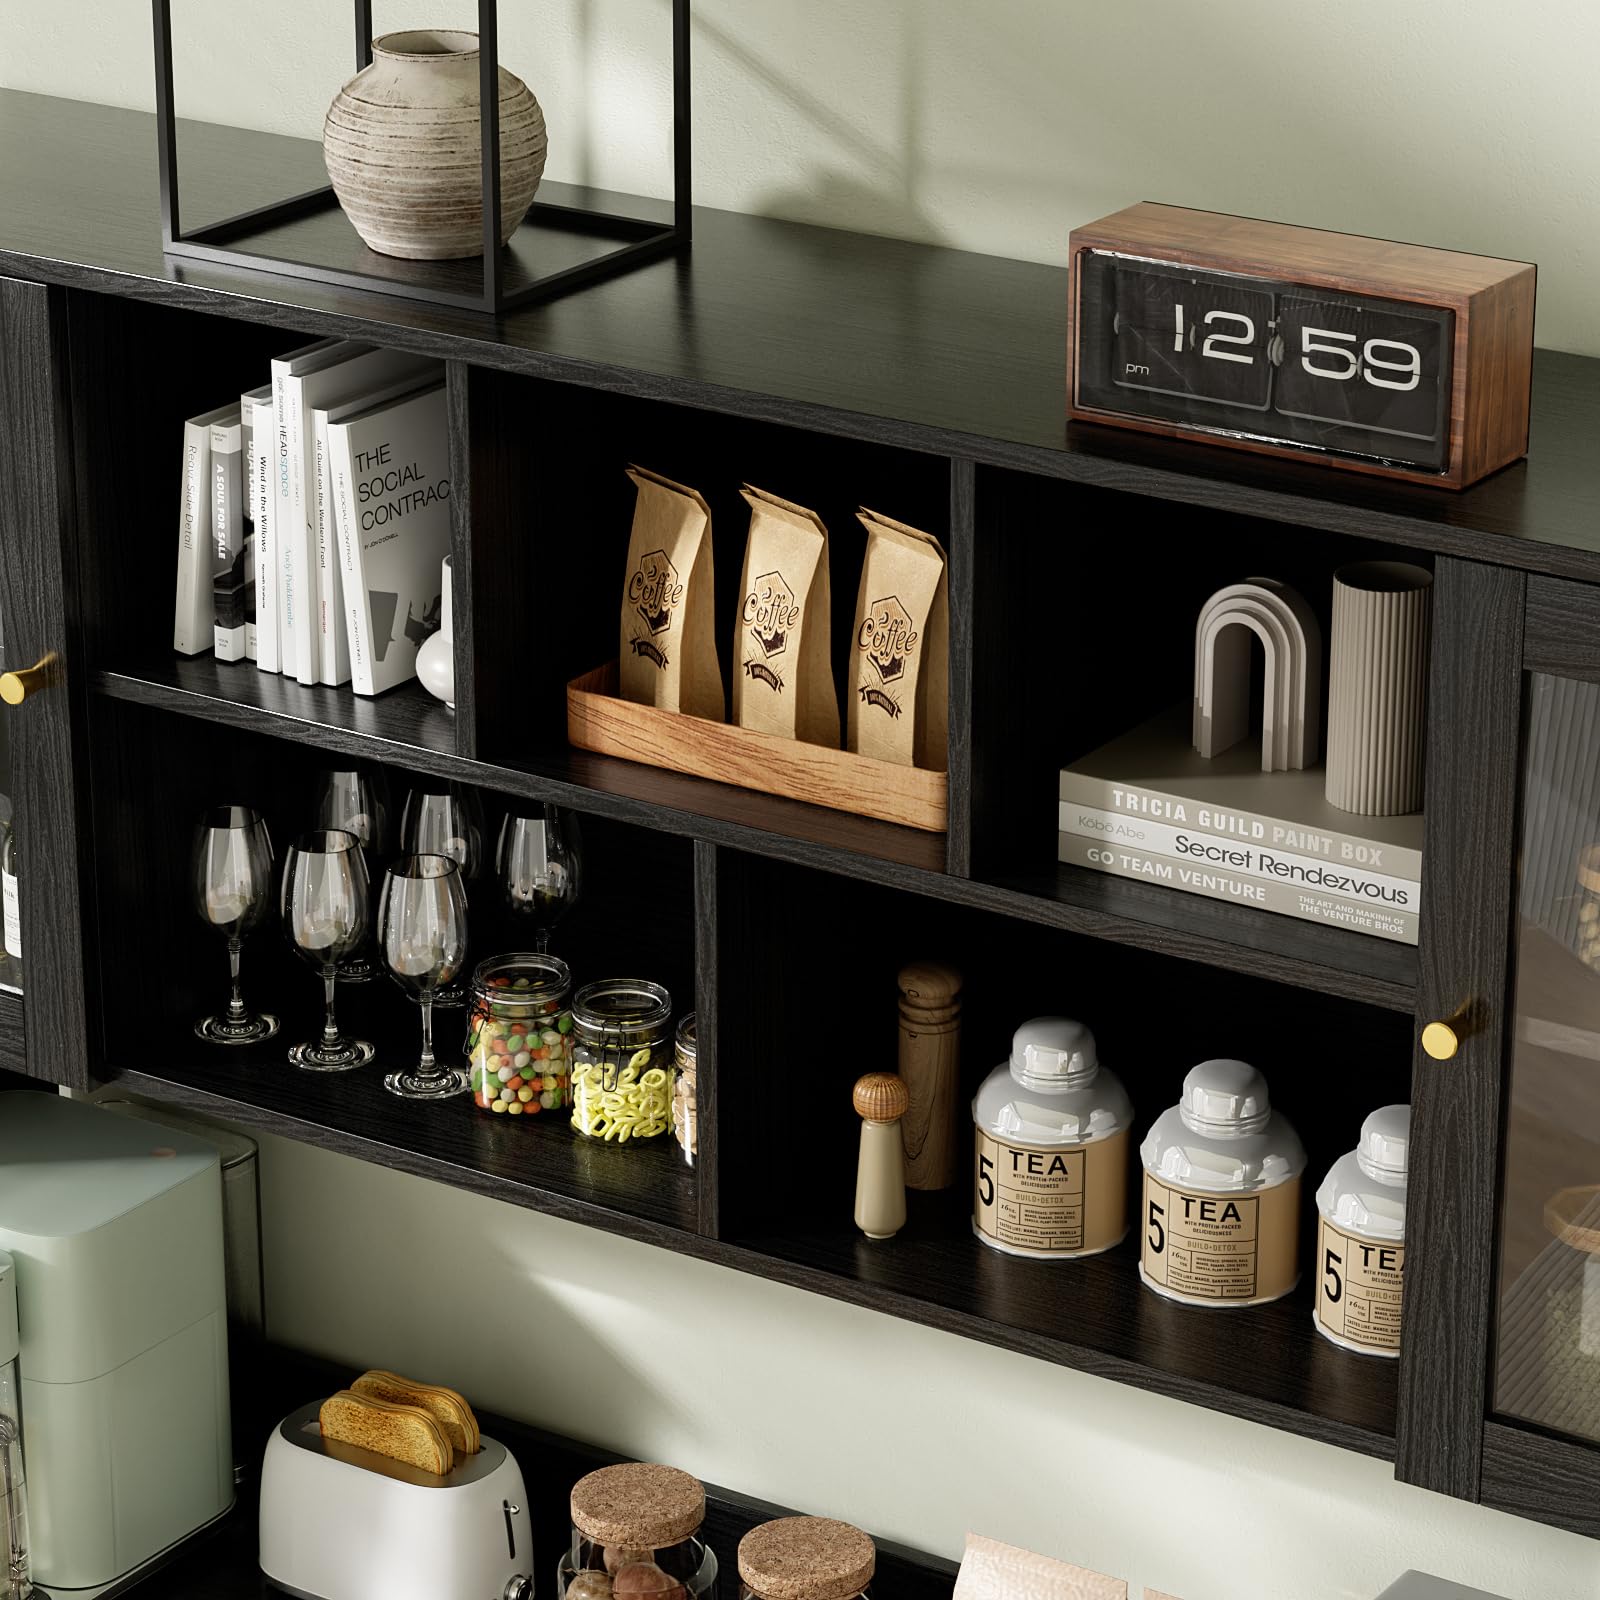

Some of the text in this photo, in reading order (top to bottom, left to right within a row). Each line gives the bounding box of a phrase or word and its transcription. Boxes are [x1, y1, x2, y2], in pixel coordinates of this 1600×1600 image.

[1175, 304, 1421, 391] 12 59
[1126, 362, 1150, 376] pm
[279, 425, 289, 498] HEADspace
[355, 443, 392, 472] THE
[185, 484, 195, 511] Side
[260, 484, 266, 493] in
[318, 479, 323, 490] on
[358, 462, 426, 503] SOCIAL
[216, 464, 226, 559] A SOUL FOR SALE
[183, 513, 194, 550] Detail
[628, 570, 683, 608] Coffee
[742, 592, 800, 630] Coffee
[857, 617, 918, 656] Coffee
[1112, 789, 1383, 867] TRICIA GUILD PAINT BOX
[1116, 824, 1145, 840] Abe
[1087, 848, 1266, 901] GO TEAM VENTURE
[1175, 834, 1408, 905] Secret Rendezvous
[1299, 895, 1315, 905] THE
[1316, 899, 1332, 909] ART
[1335, 903, 1354, 914] AND
[1393, 918, 1405, 926] OF
[1299, 902, 1404, 935] THE VENTURE BROS
[979, 1153, 994, 1206] 5
[1009, 1150, 1068, 1175] TEA
[1148, 1199, 1165, 1254] 5
[1180, 1196, 1241, 1222] TEA
[1192, 1228, 1232, 1236] DELICIOUSNESS
[1324, 1248, 1342, 1303] 5
